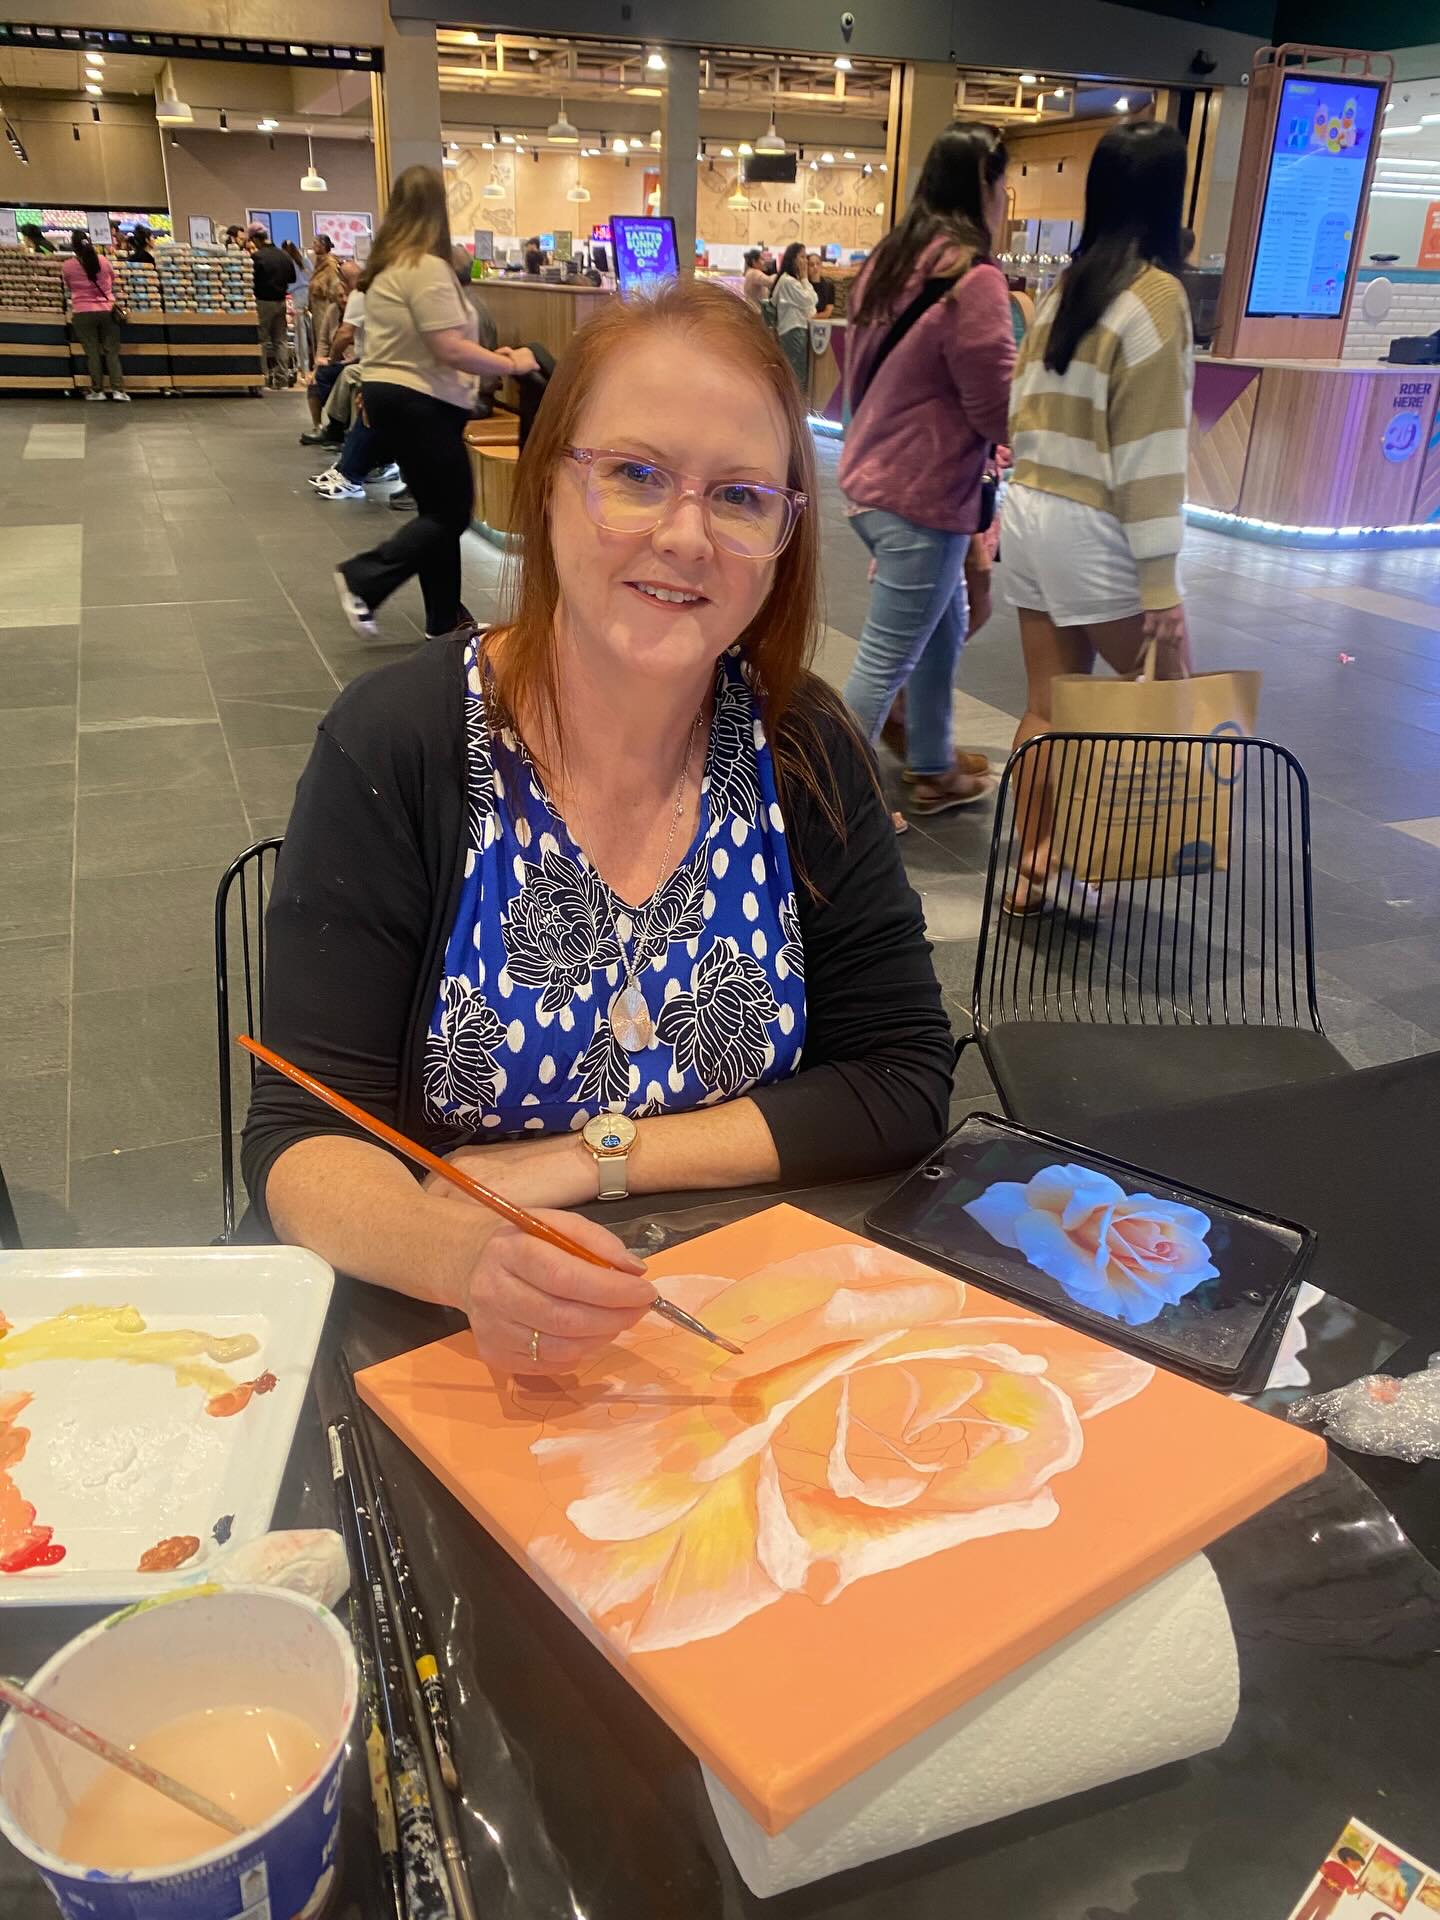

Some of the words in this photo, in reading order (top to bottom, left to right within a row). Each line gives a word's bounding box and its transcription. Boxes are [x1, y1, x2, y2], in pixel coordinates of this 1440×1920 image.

[777, 198, 800, 213] the
[625, 231, 662, 241] EASTER
[627, 239, 662, 250] BUNNY
[634, 248, 658, 258] CUPS
[1393, 396, 1424, 407] HERE
